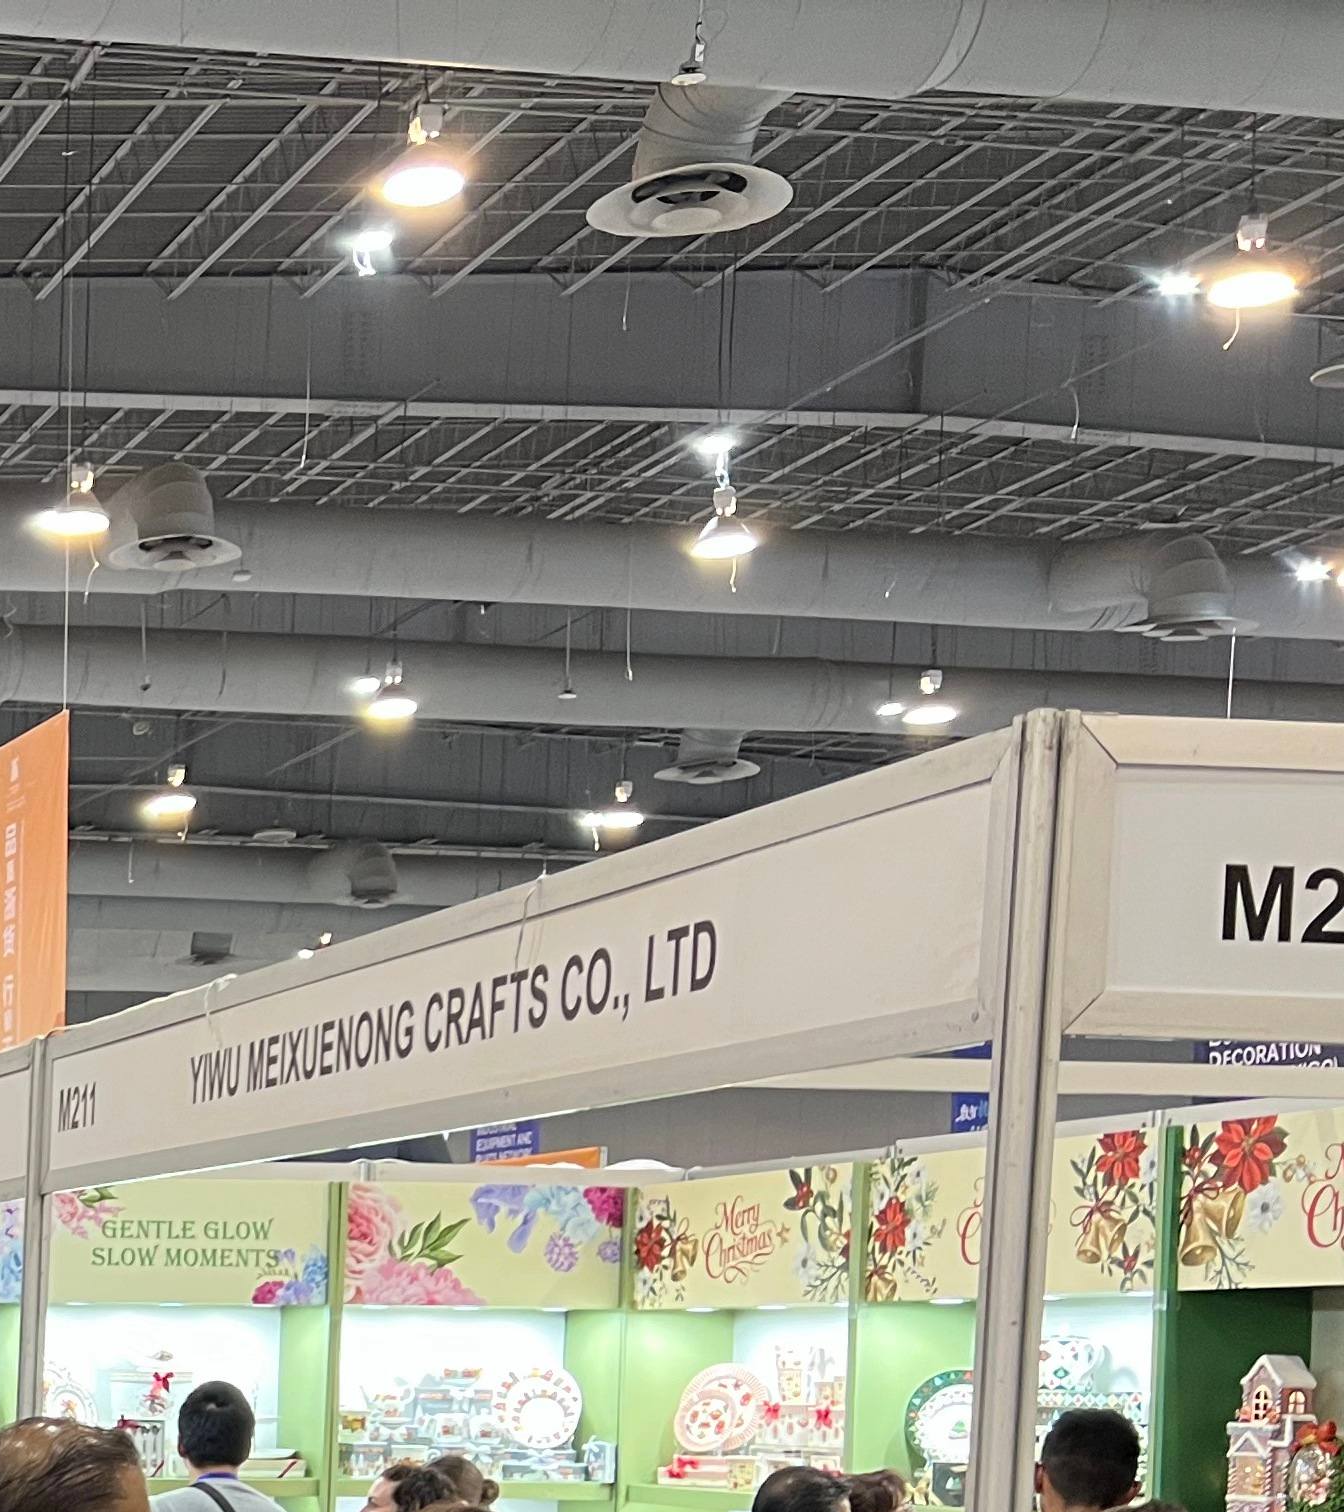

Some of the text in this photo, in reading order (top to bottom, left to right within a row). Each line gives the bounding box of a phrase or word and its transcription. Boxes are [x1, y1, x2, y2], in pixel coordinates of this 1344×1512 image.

[190, 920, 718, 1104] YIWU MEIXUENONG CRAFTS CO., LTD
[1209, 1042, 1322, 1066] DECORATION
[57, 1081, 97, 1133] M211
[102, 1217, 274, 1240] GENTLE GLOW
[715, 1195, 761, 1235] Merry
[91, 1244, 281, 1268] SLOW MOMENTS
[703, 1229, 773, 1279] Christmas
